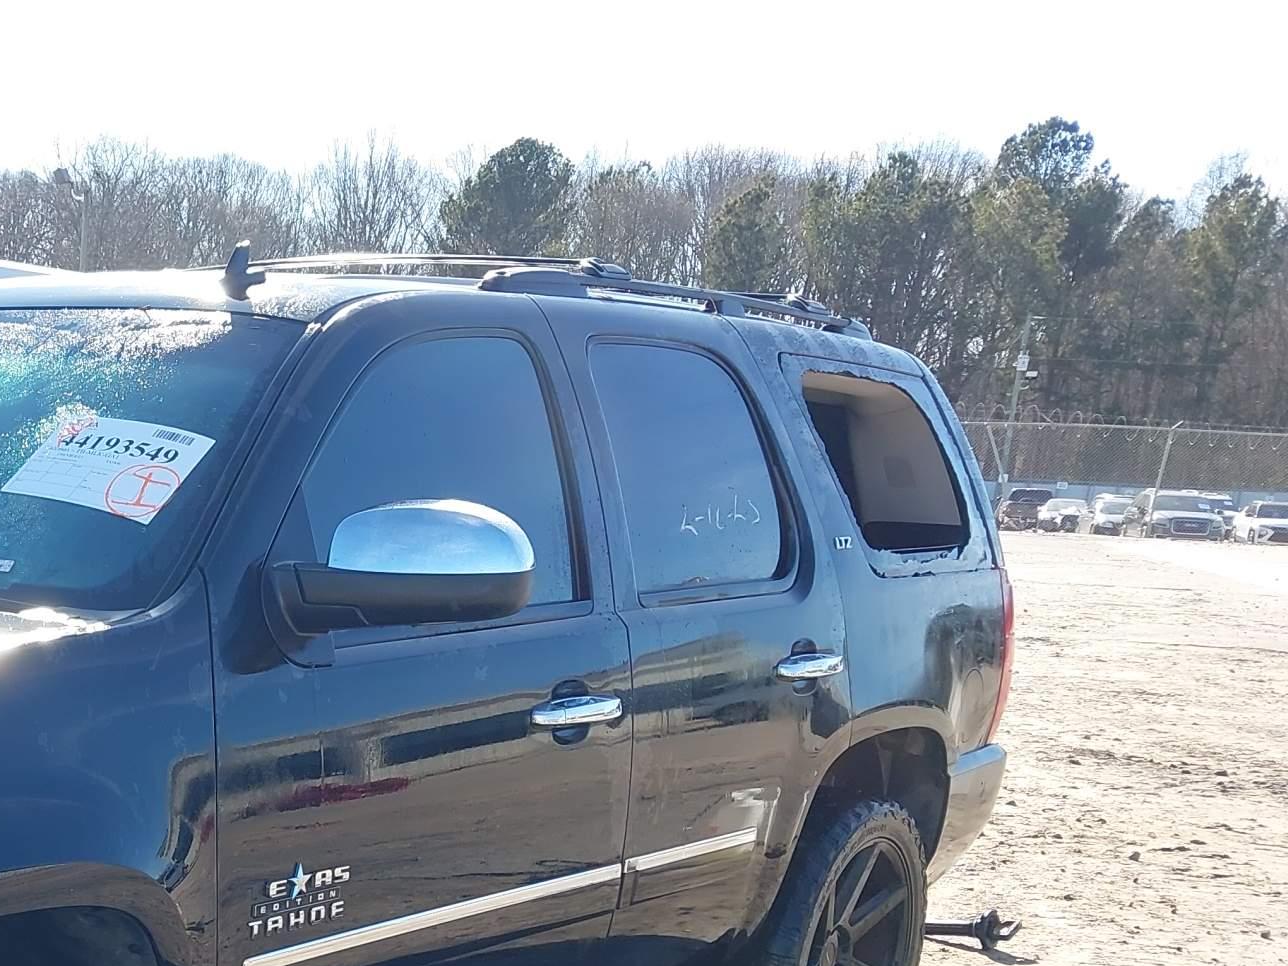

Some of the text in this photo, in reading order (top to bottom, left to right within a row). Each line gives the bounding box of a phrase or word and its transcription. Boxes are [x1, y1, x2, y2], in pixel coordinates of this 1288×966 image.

[59, 433, 180, 464] 44193549
[835, 536, 853, 550] LTZ
[259, 890, 338, 914] EDITION
[247, 900, 346, 939] TAHOE
